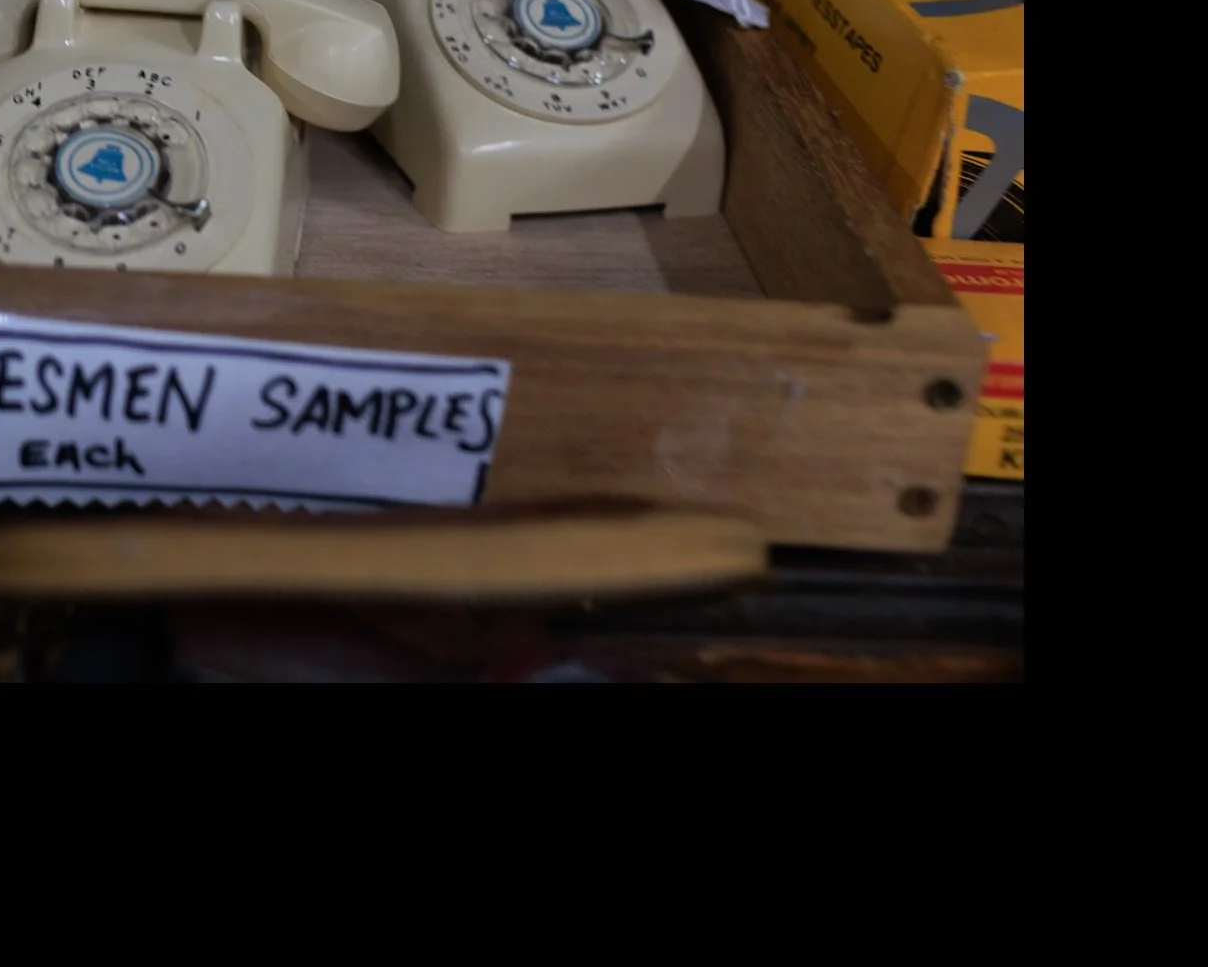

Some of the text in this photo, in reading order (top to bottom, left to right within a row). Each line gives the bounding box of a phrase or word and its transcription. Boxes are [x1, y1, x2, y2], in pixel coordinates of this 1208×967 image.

[71, 66, 108, 81] DEF
[137, 68, 174, 88] ABC
[250, 374, 502, 453] SAMPLES
